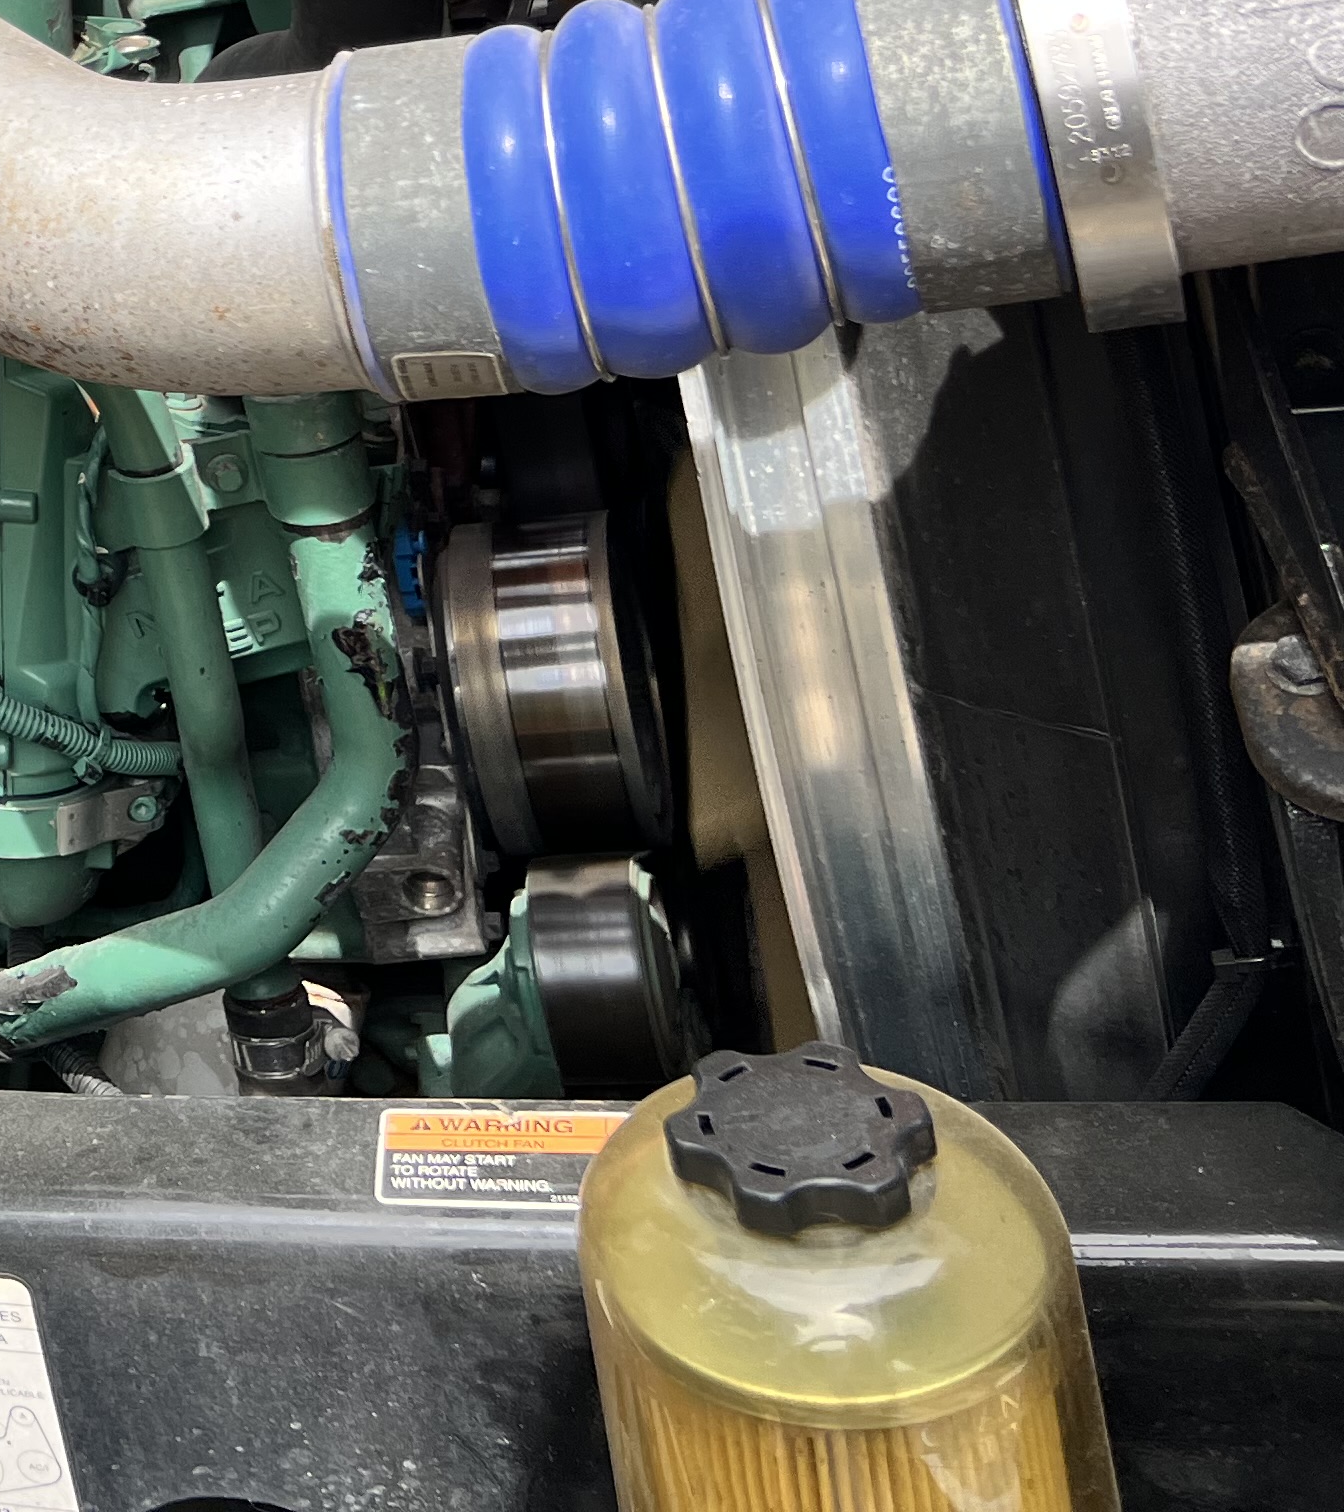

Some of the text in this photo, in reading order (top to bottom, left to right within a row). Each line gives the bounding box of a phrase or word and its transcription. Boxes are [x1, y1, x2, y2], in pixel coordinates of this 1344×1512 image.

[439, 1118, 573, 1133] WARNING
[441, 1138, 545, 1149] CLUTCH FAN
[392, 1153, 516, 1166] FAN MAY START
[392, 1165, 478, 1177] TO ROTATE
[390, 1176, 554, 1193] WITHOUT WARNING.
